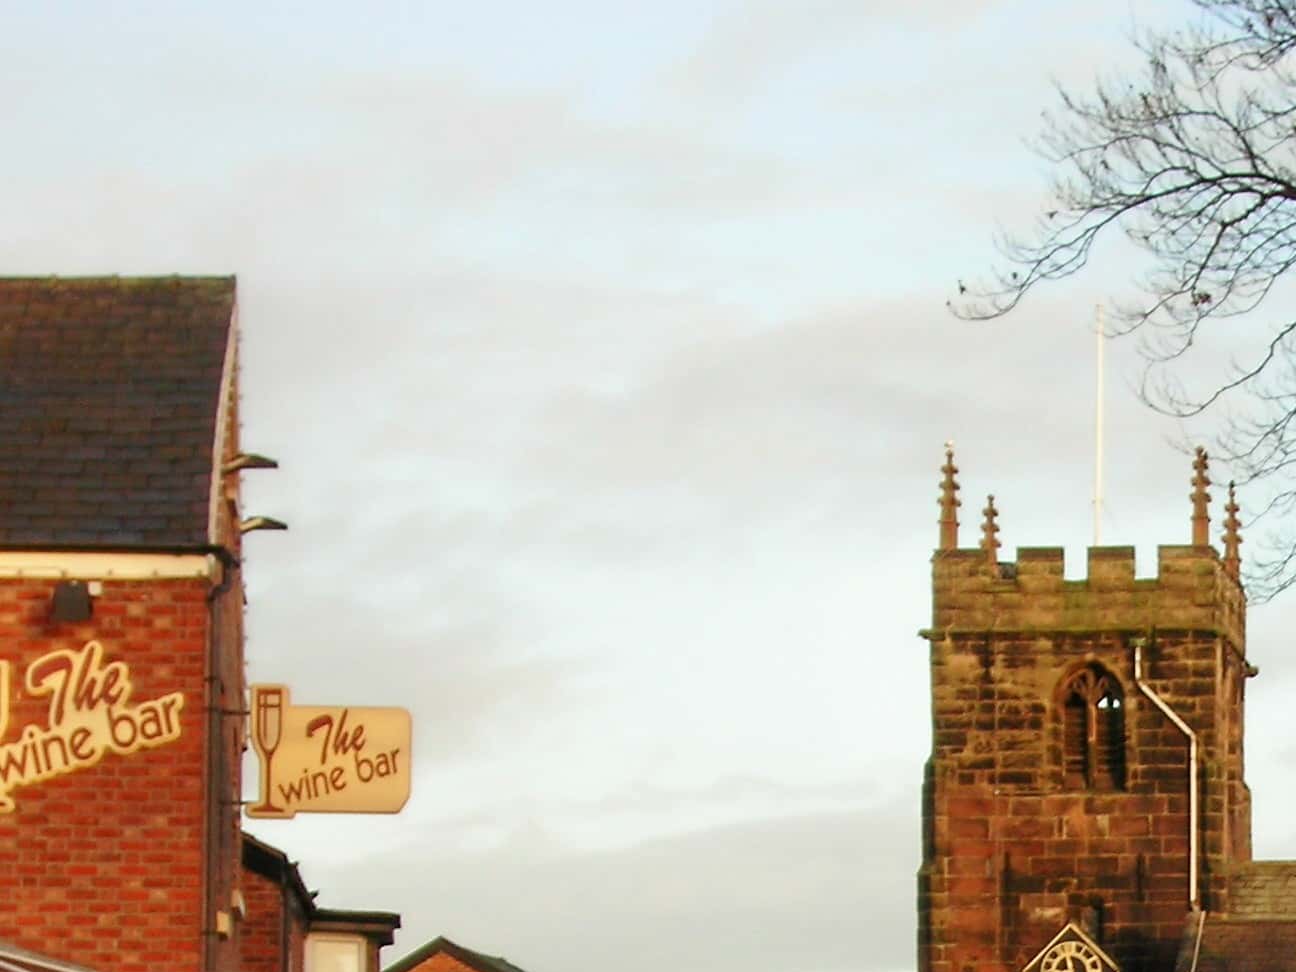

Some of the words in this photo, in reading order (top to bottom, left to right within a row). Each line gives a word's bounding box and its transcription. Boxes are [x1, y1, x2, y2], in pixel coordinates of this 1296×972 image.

[30, 645, 126, 726] The
[0, 727, 96, 782] wine
[106, 697, 178, 748] bar
[306, 708, 366, 765] The
[278, 766, 347, 804] wine
[354, 748, 400, 783] bar
